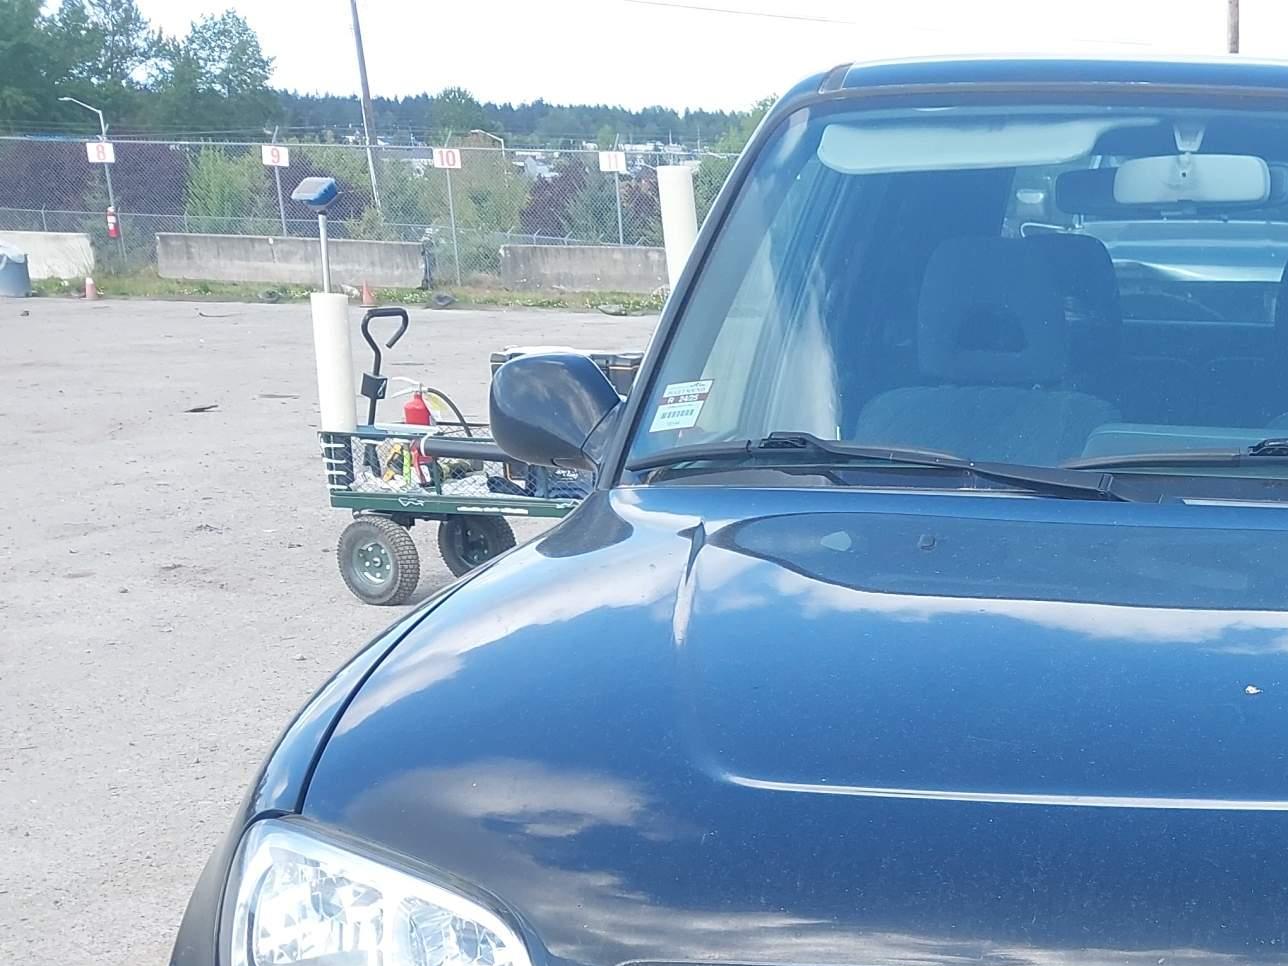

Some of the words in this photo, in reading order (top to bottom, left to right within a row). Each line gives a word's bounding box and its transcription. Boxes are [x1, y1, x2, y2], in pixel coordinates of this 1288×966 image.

[95, 143, 107, 161] 8
[270, 148, 280, 164] 9
[439, 150, 456, 167] 10
[607, 153, 619, 170] 11
